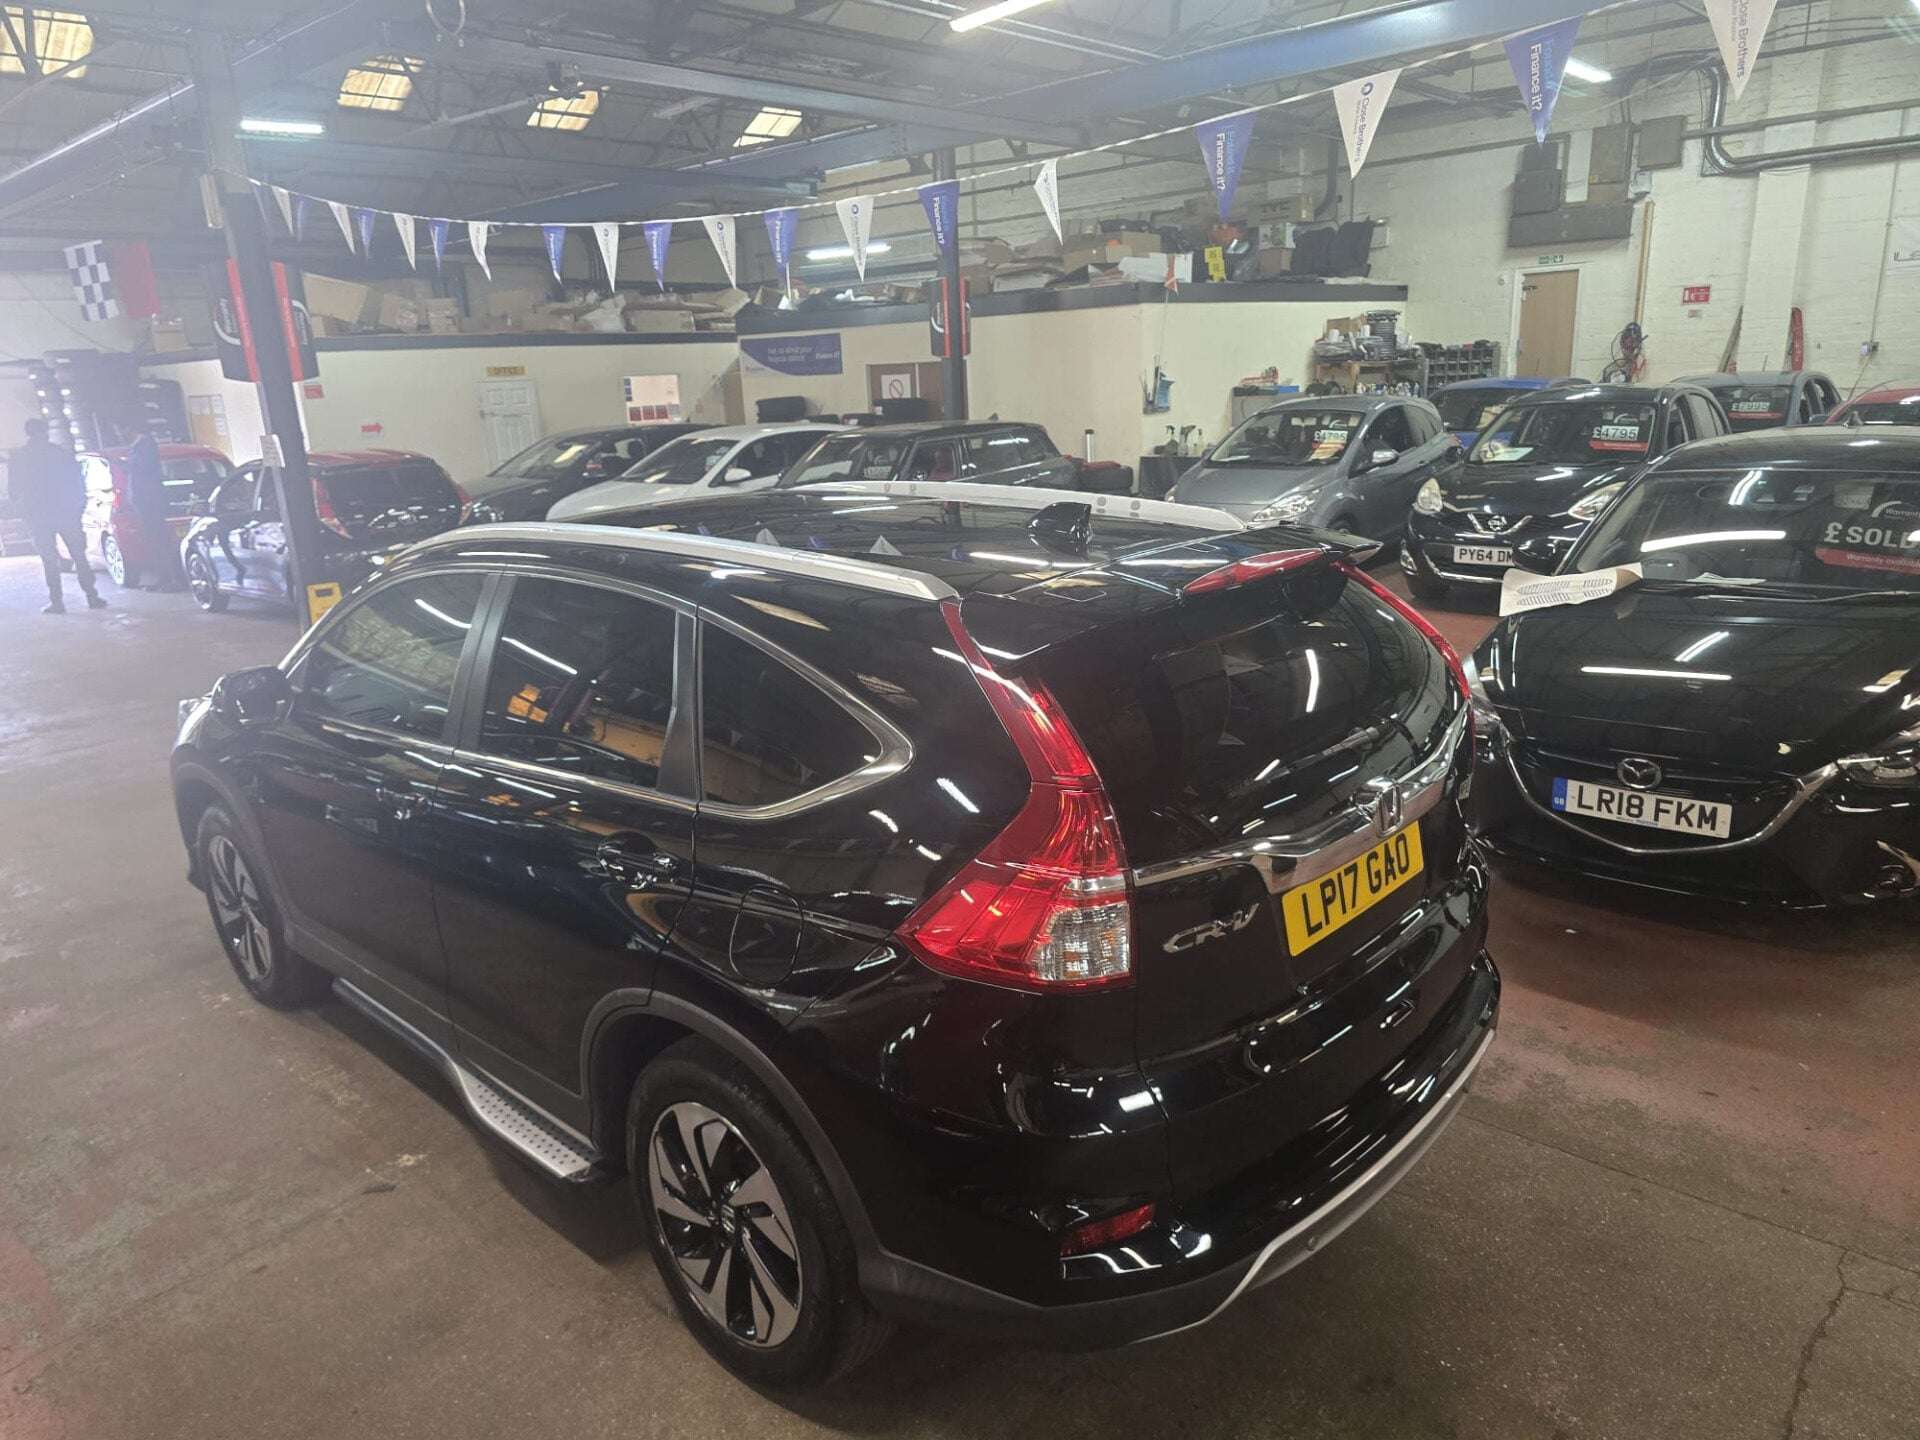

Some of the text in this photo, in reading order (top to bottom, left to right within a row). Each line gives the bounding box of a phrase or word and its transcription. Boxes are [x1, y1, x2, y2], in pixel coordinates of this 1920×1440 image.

[1530, 43, 1543, 112] Finance it?
[1216, 132, 1226, 191] Finance it?
[932, 196, 942, 232] Finance
[1592, 426, 1639, 441] £4795
[1459, 547, 1514, 564] PY64 DM
[1577, 784, 1719, 831] LR18 FKM
[1301, 832, 1410, 938] LP17 GAO
